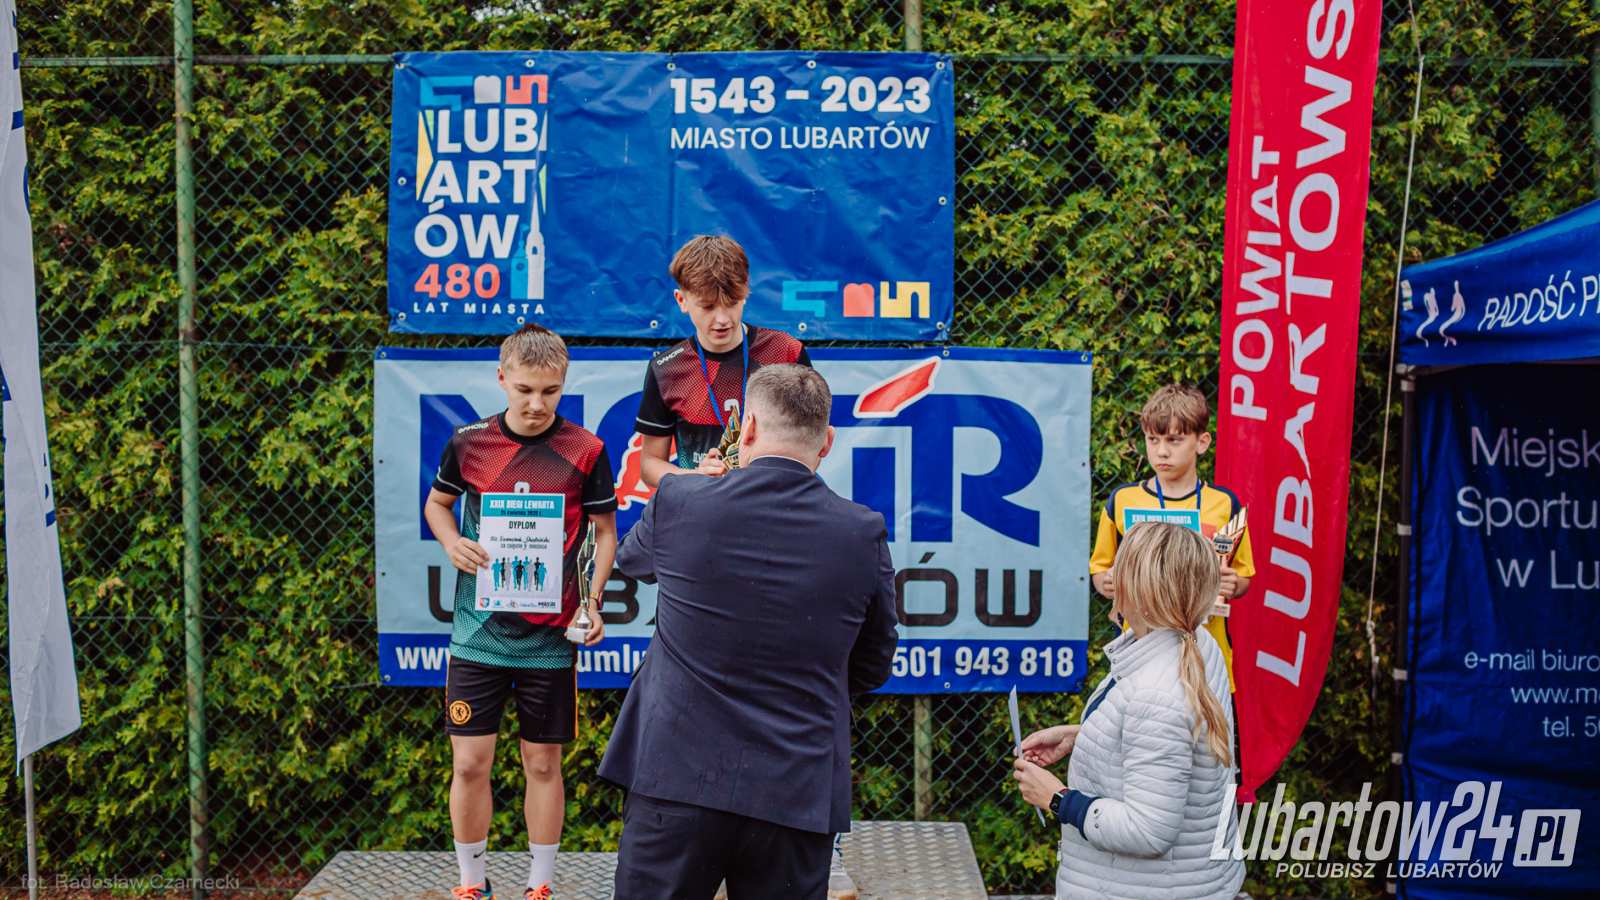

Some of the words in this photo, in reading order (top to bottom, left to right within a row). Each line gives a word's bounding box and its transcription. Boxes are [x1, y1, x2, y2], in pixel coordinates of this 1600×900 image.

[670, 76, 776, 115] 1543
[820, 76, 931, 114] 2023
[437, 108, 539, 153] LUB
[670, 127, 773, 150] MIASTO
[780, 120, 930, 150] LUBARTÓW
[422, 159, 536, 204] ART
[414, 198, 520, 259] ÓW
[414, 263, 500, 299] 480
[1230, 135, 1283, 422] POWIAT
[413, 303, 449, 313] LAT
[464, 303, 545, 315] MIASTA
[1477, 269, 1576, 331] RADOŚĆ
[508, 521, 536, 530] DYPLOM
[1456, 486, 1598, 536] Sportu
[1496, 558, 1535, 588] w
[1551, 549, 1600, 590] Lu
[891, 647, 941, 677] 501
[955, 646, 1010, 677] 943
[1020, 647, 1074, 677] 818
[1464, 648, 1535, 672] e-mail
[1510, 686, 1600, 704] www.m
[1542, 715, 1575, 738] tel.
[1583, 715, 1600, 738] 5
